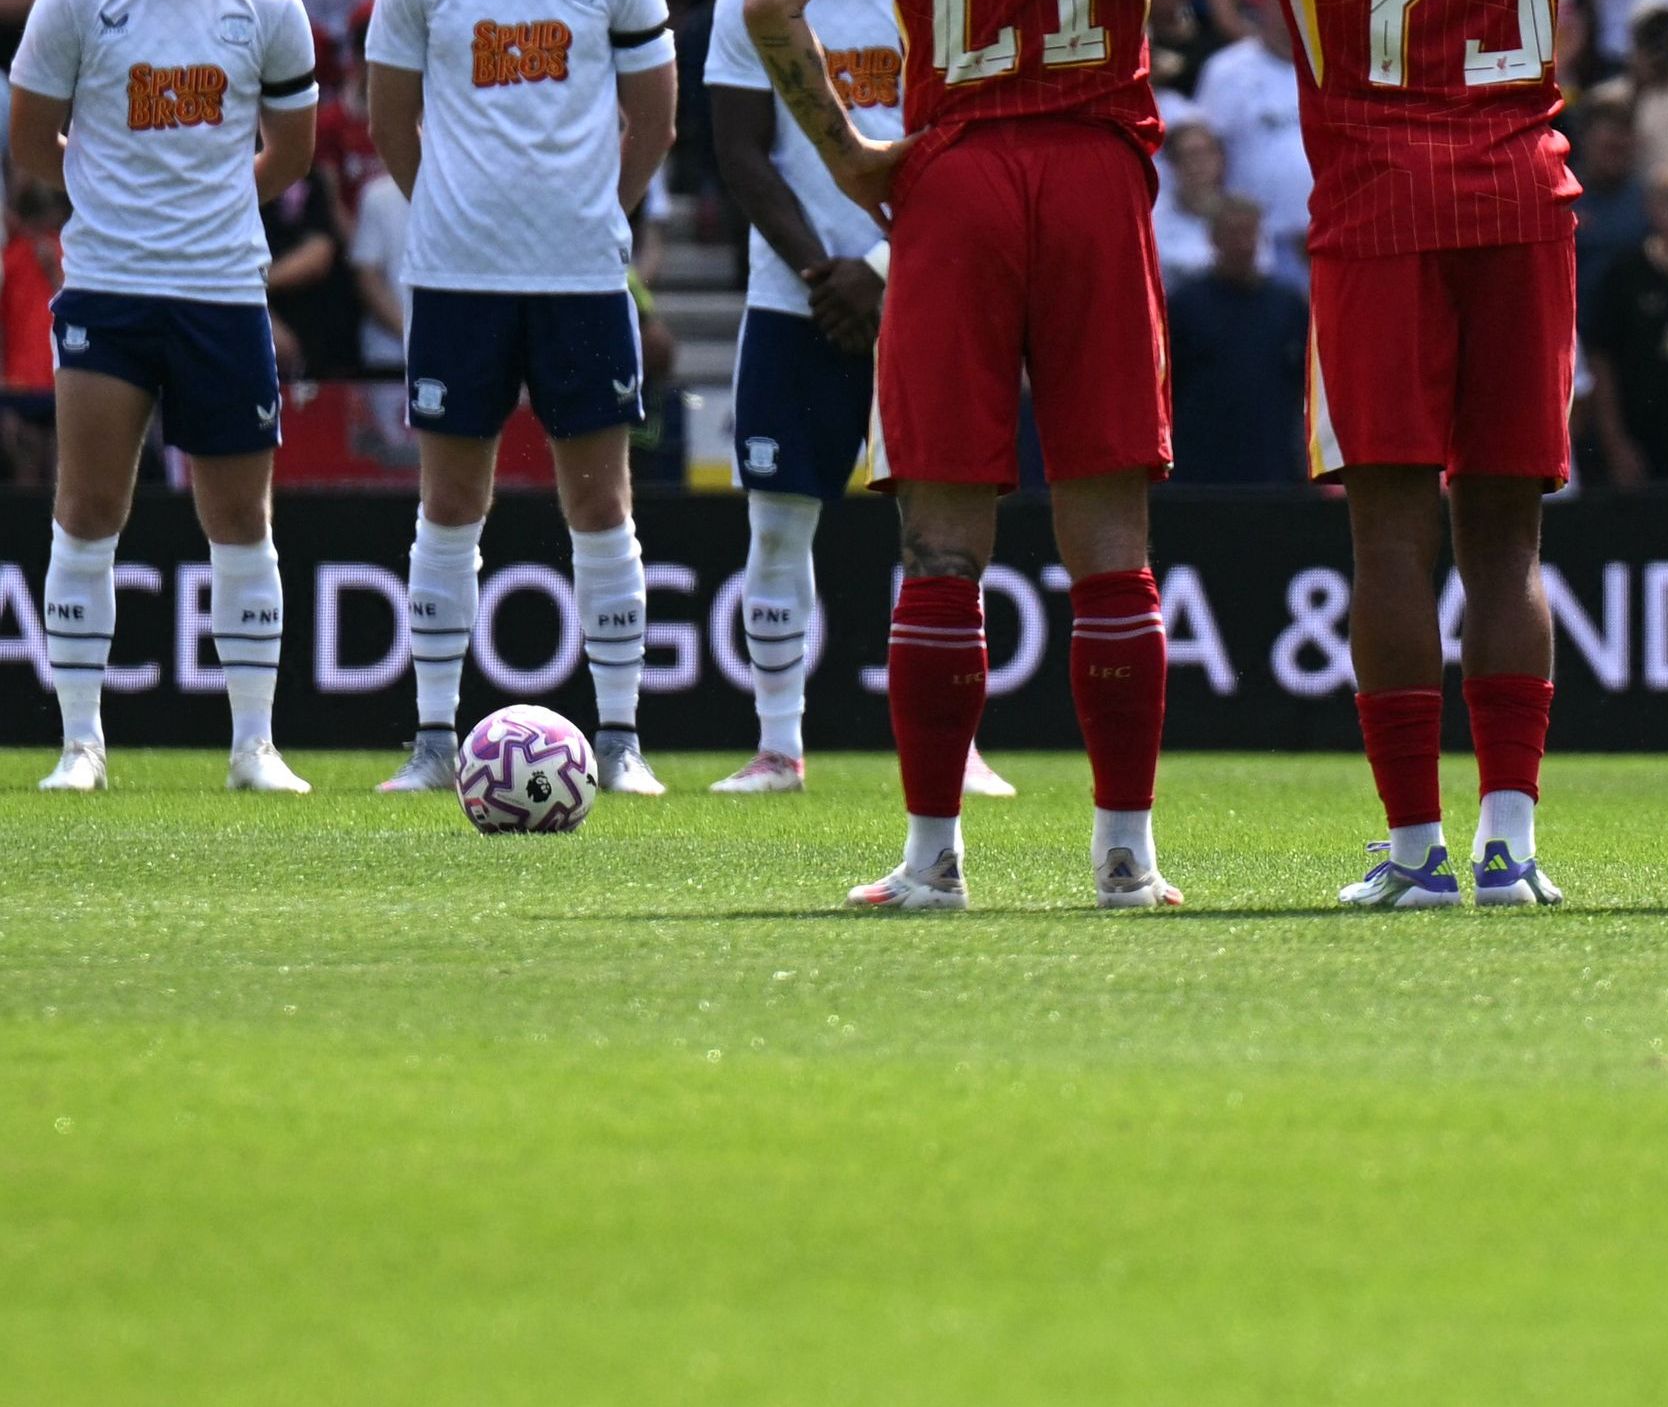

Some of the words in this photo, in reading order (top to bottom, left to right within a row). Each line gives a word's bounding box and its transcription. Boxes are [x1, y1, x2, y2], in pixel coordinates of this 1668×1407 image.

[474, 19, 573, 52] SPUD
[472, 44, 569, 87] BROS
[824, 46, 901, 79] PUD
[128, 62, 228, 97] SPUD
[832, 75, 899, 110] ROS
[127, 87, 223, 130] BROS
[47, 602, 84, 620] PNE
[241, 608, 279, 623] PNE
[408, 602, 437, 617] NE
[598, 610, 638, 627] PNE
[752, 608, 790, 623] PNE
[314, 562, 828, 695] DOGO
[1270, 566, 1358, 698] &
[1089, 664, 1132, 679] LFC
